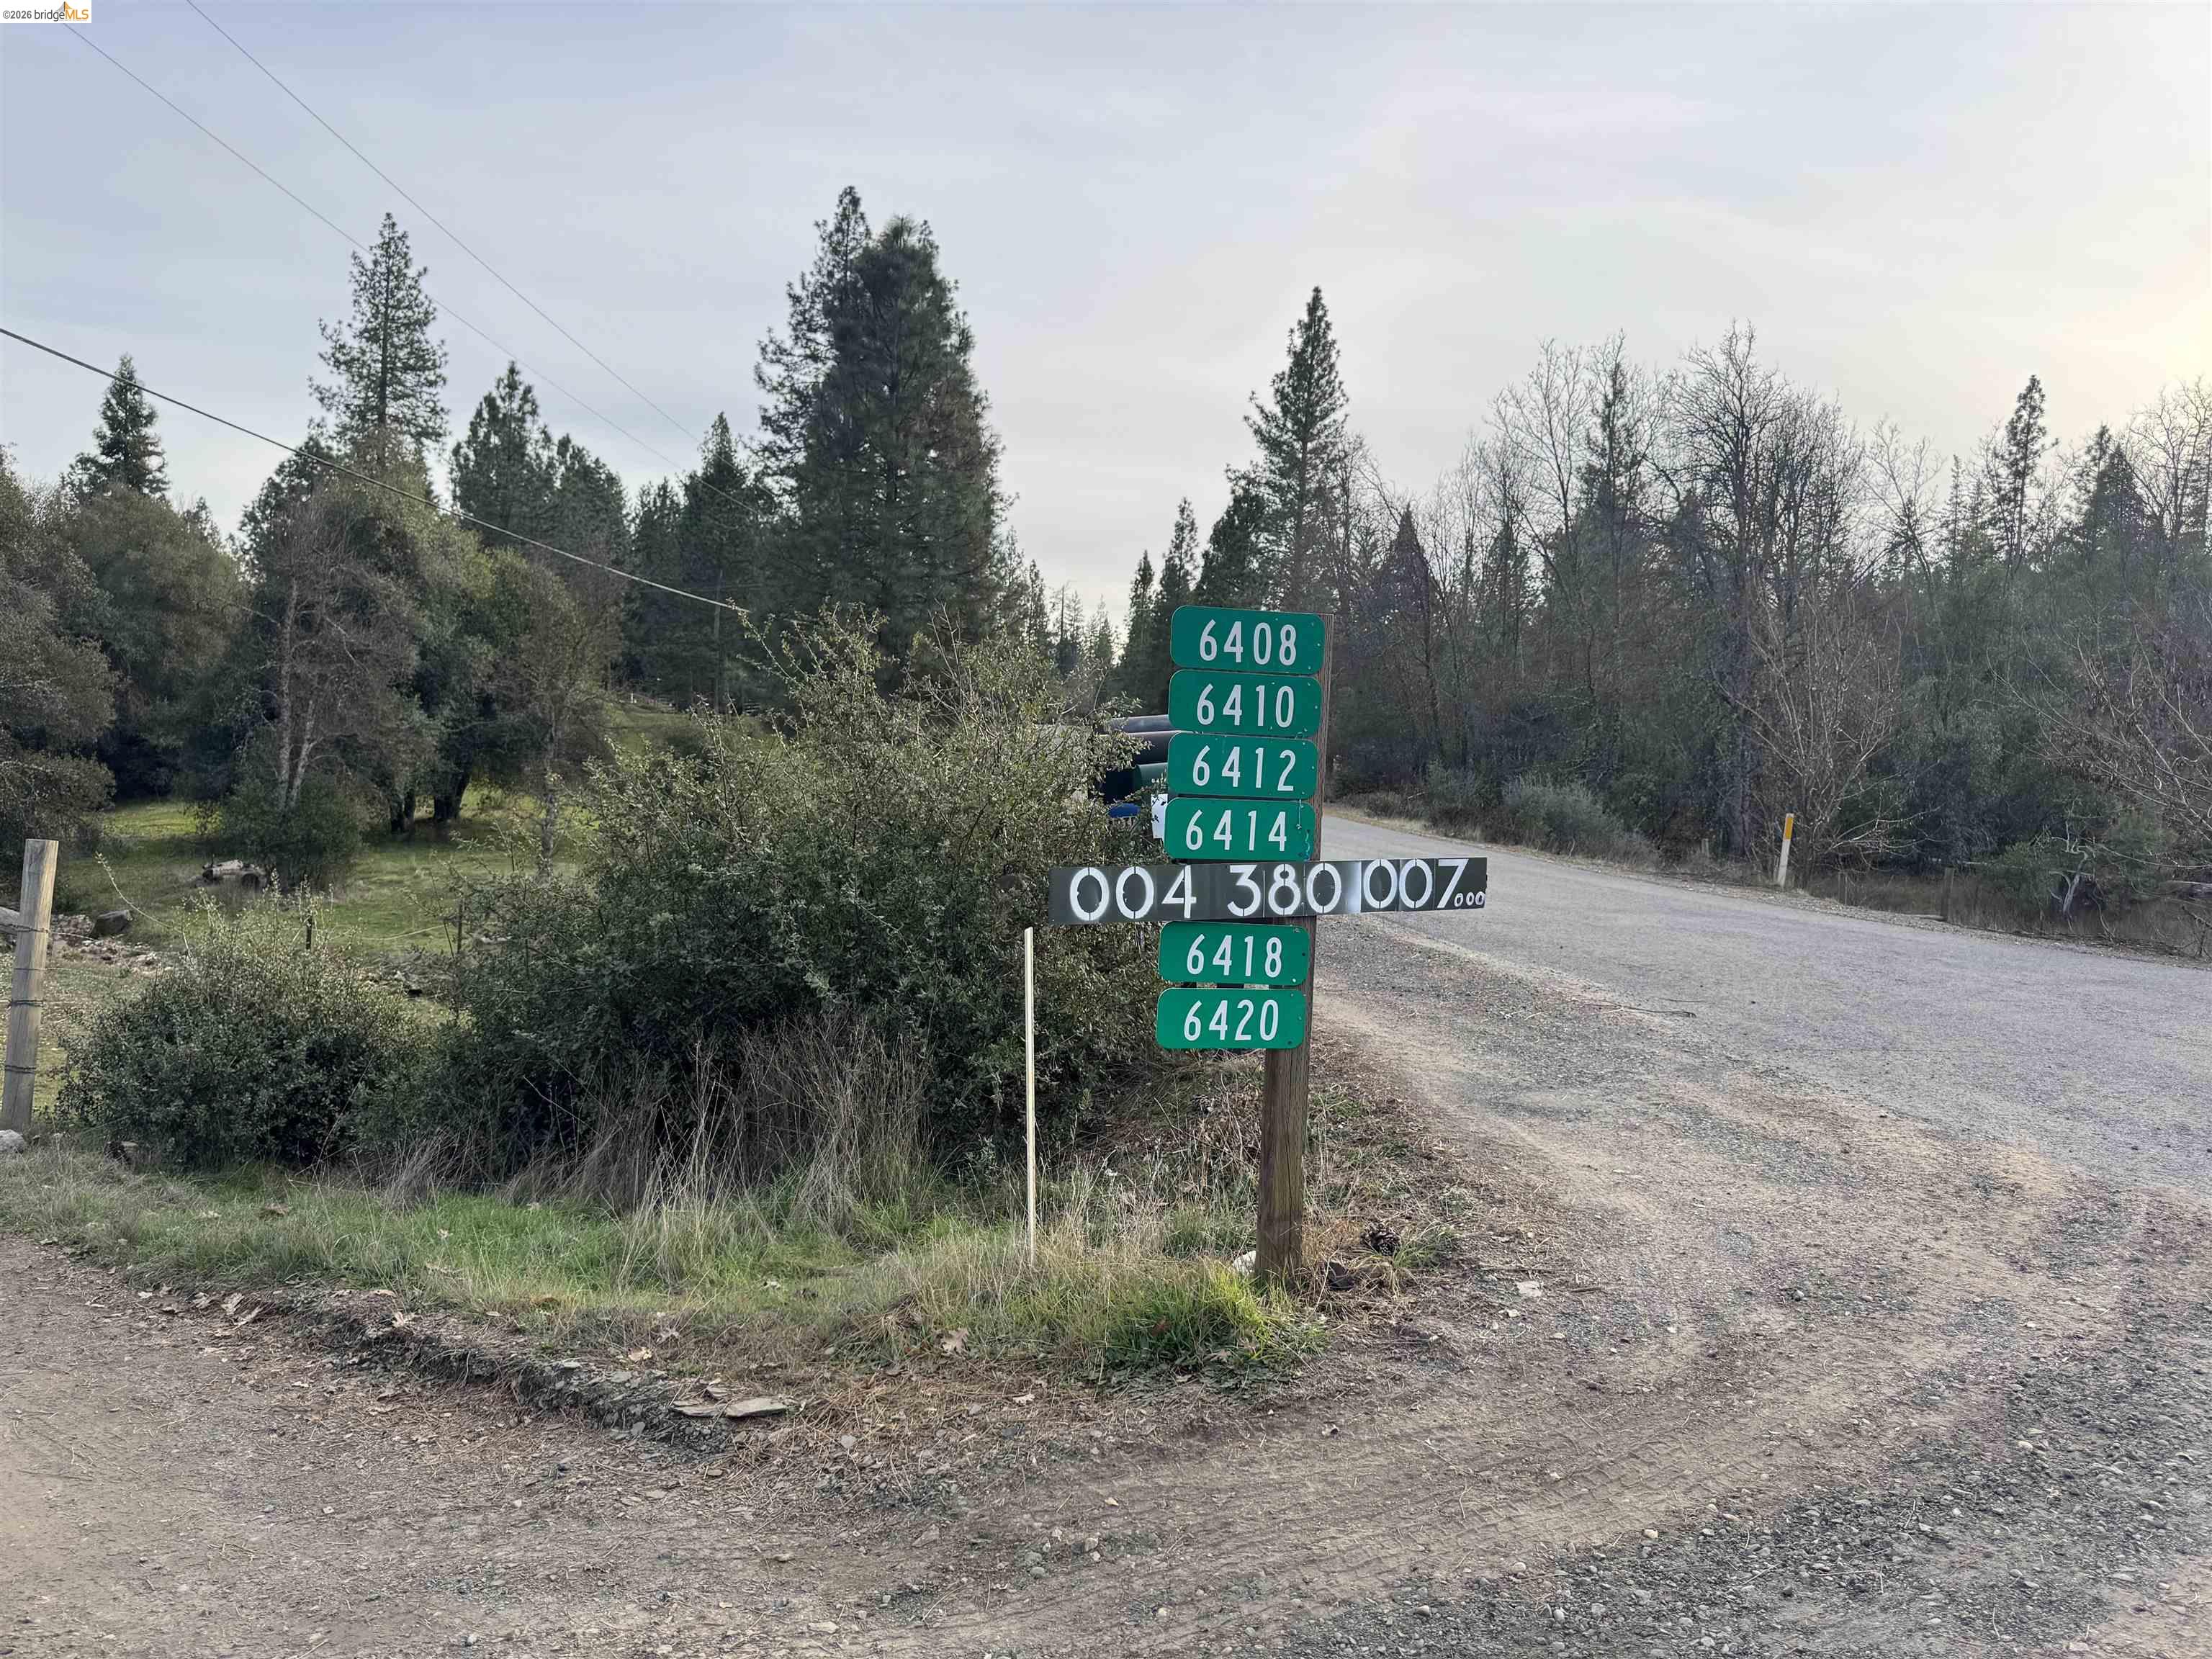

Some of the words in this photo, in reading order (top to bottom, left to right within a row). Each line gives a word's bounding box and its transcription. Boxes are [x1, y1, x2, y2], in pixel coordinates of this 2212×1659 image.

[1199, 619, 1297, 666] 6408
[1196, 683, 1295, 729] 6410
[1192, 745, 1297, 792] 6412
[1185, 809, 1287, 852] 6414
[1069, 865, 1197, 921] 004
[1227, 863, 1341, 917] 380
[1363, 858, 1469, 909] 007
[1186, 933, 1283, 978] 6418
[1183, 999, 1280, 1042] 6420
